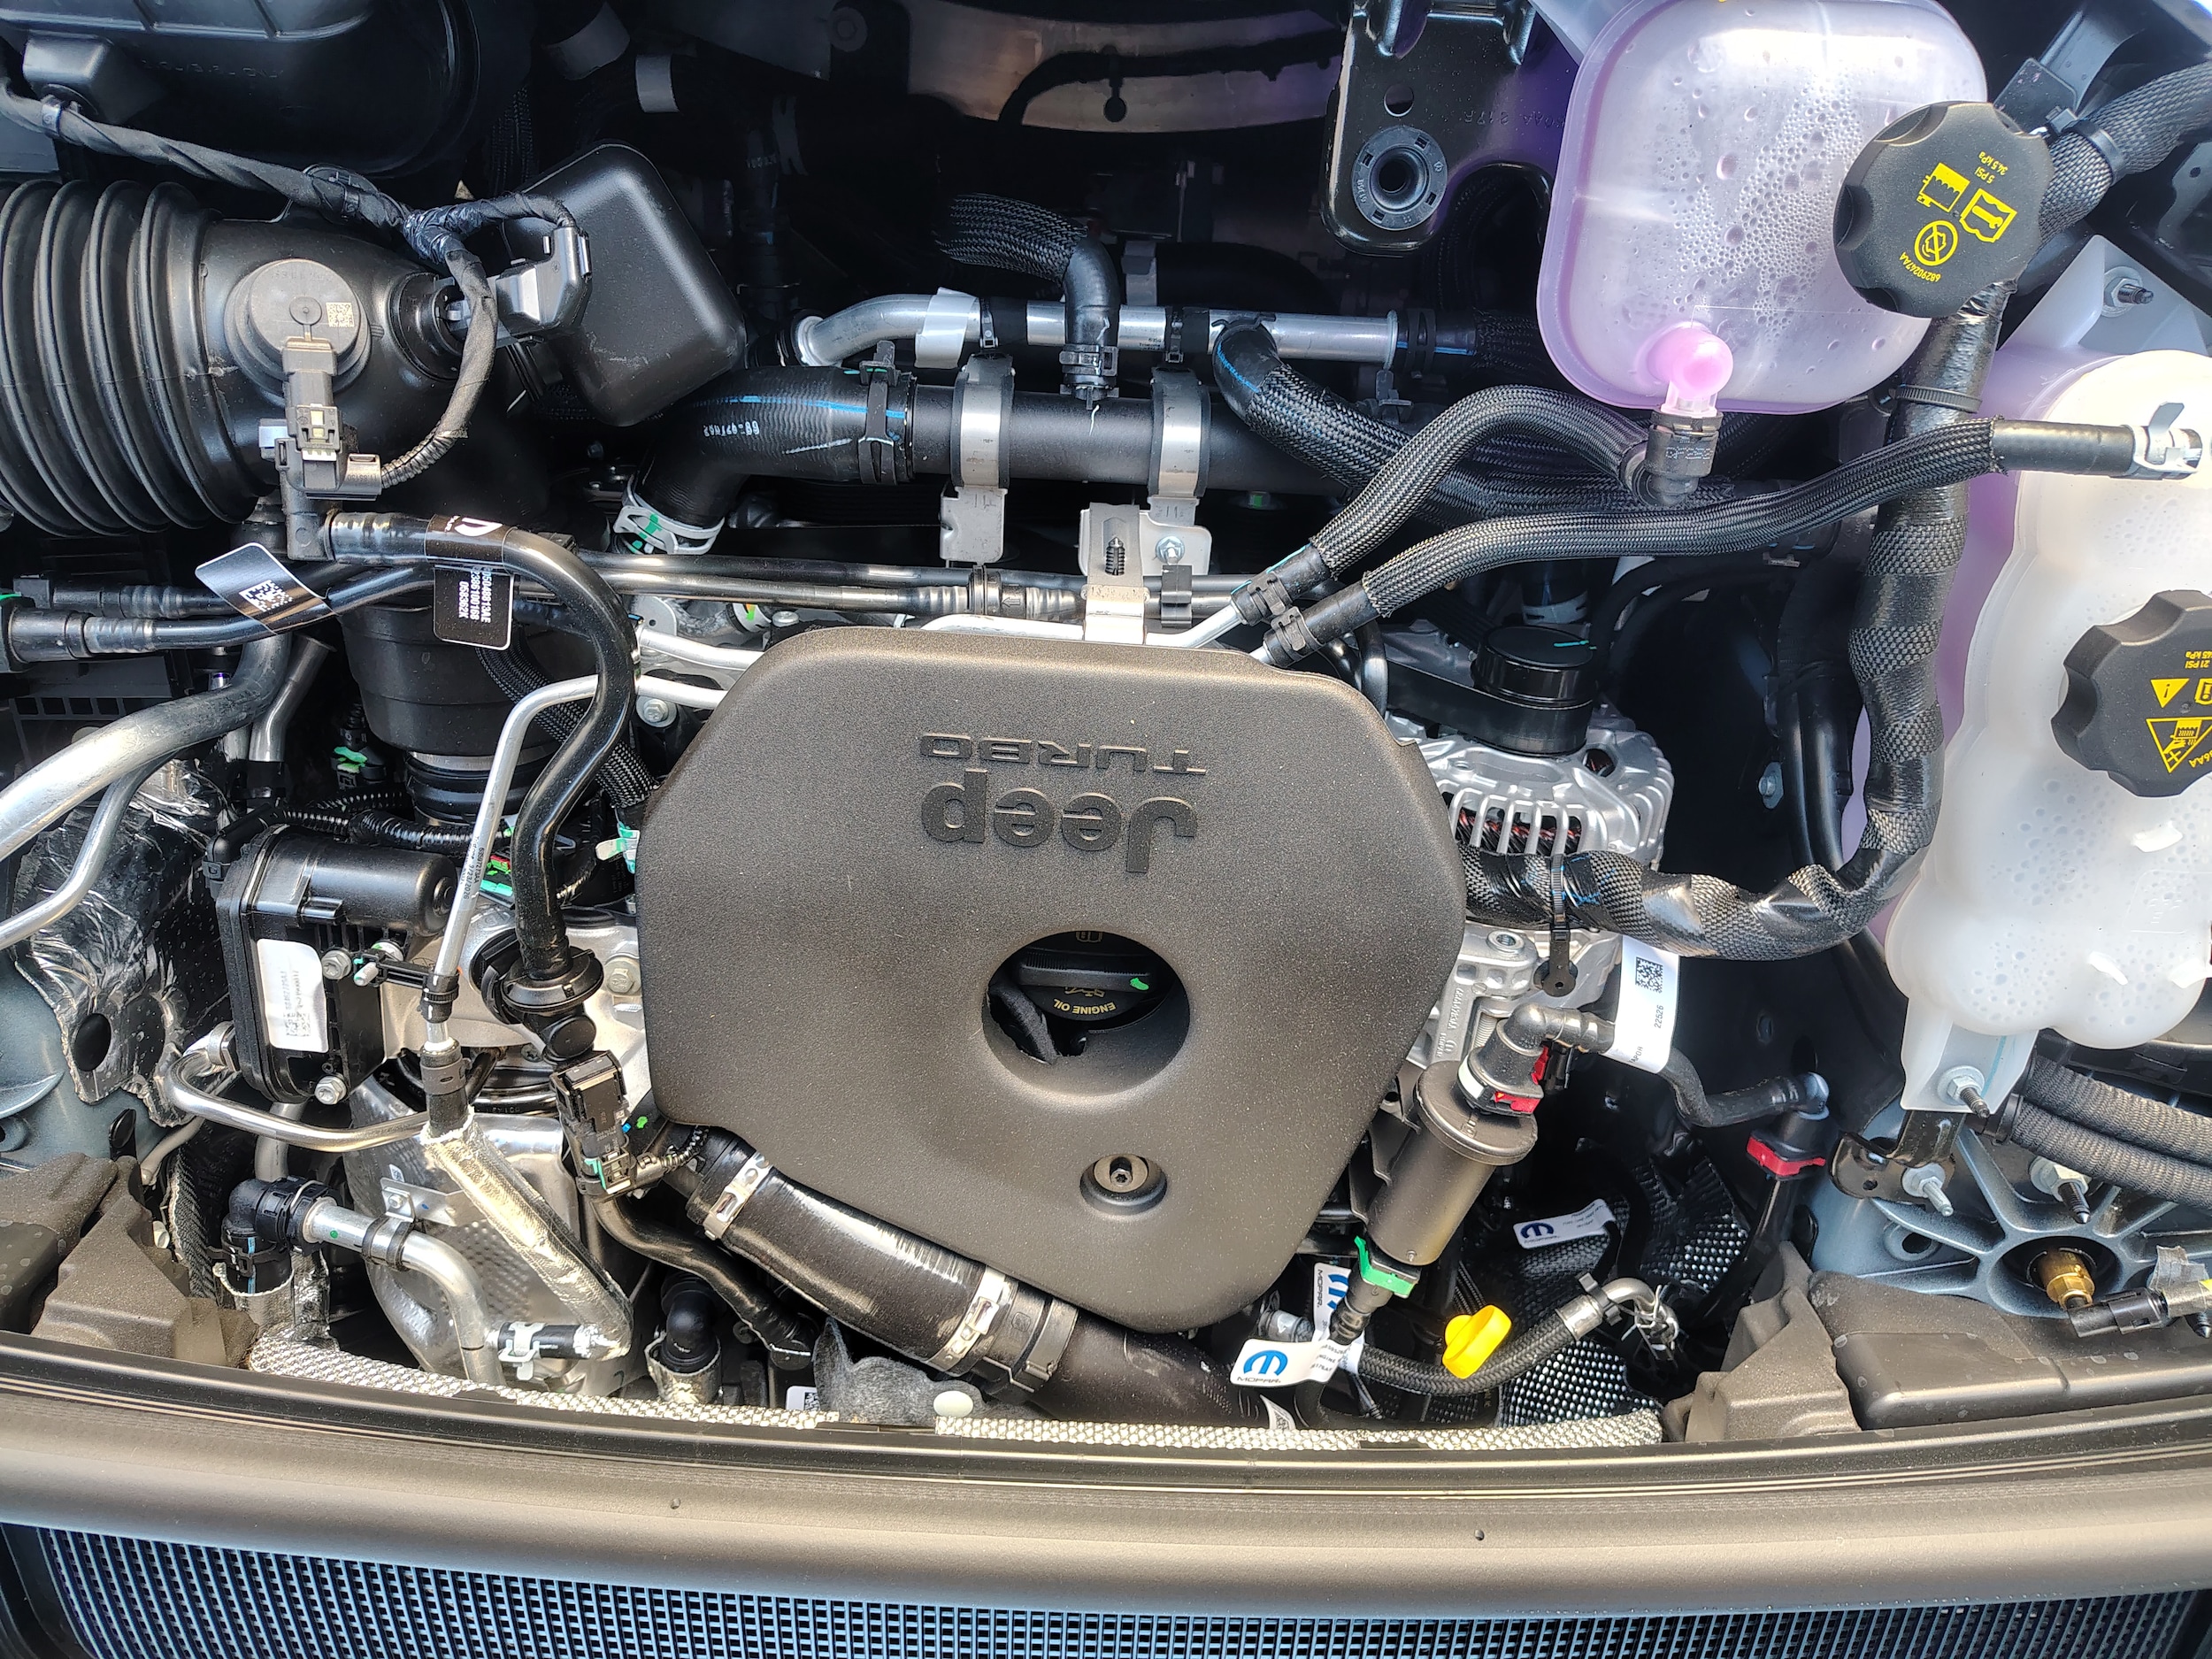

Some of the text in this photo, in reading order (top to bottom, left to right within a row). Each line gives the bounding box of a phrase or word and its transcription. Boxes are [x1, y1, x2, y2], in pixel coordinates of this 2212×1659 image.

[1974, 166, 1995, 184] 5 PSI
[1978, 151, 2008, 176] 34.5 kPa
[1899, 251, 1941, 282] 68290247AA
[458, 580, 469, 618] 058362K
[2185, 659, 2210, 669] 21 PSI
[919, 733, 1207, 774] TURBO
[920, 768, 1198, 873] Jeep
[1053, 998, 1117, 1015] ENGINE OIL
[1654, 1004, 1664, 1029] 22526
